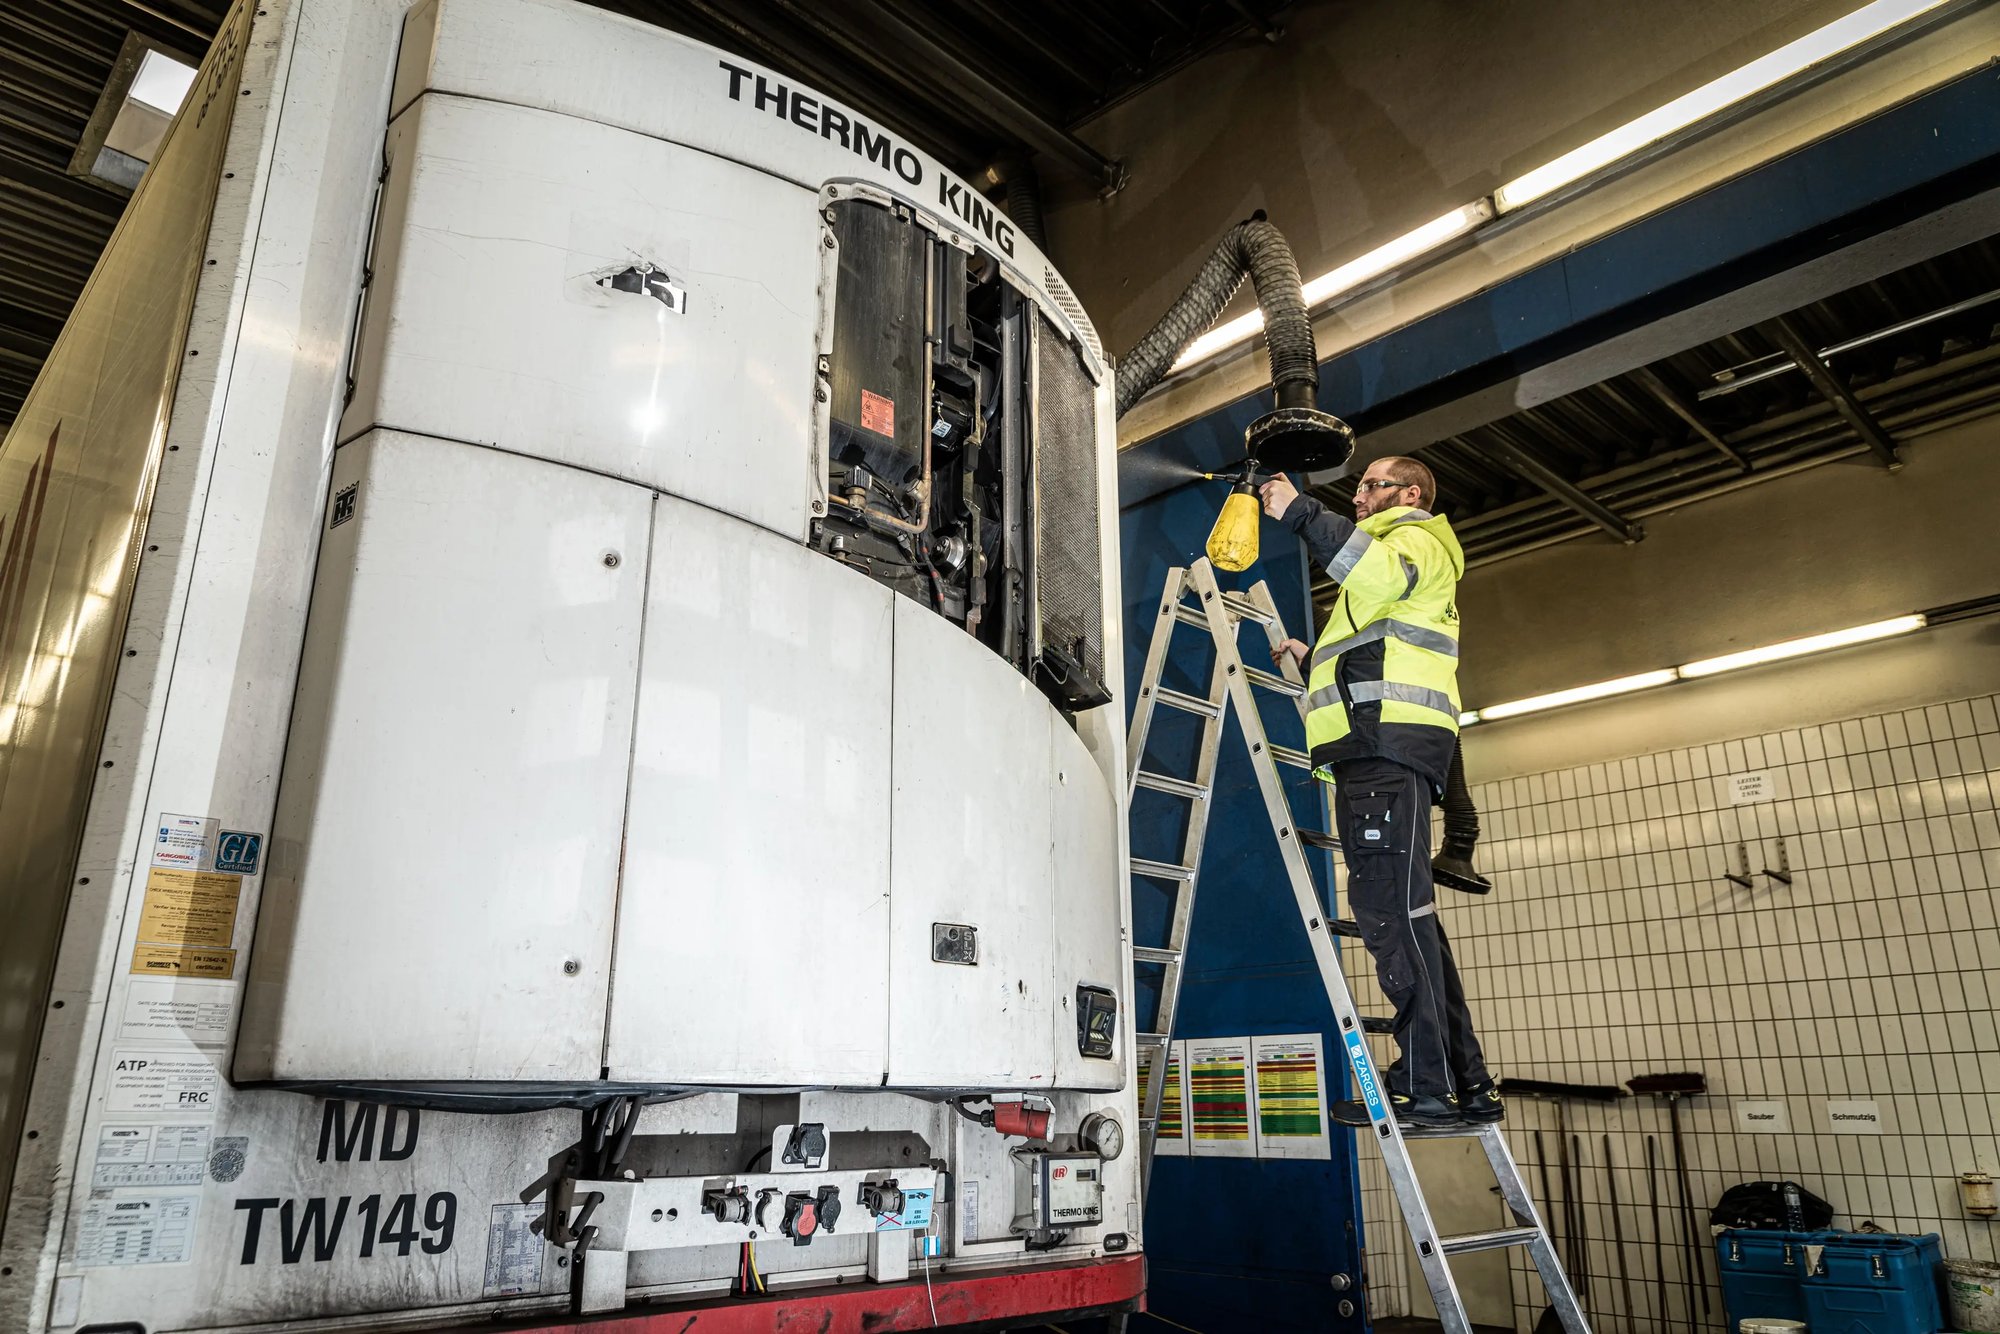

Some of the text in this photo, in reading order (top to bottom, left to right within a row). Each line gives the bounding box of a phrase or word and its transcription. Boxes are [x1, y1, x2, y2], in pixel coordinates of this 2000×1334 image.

[719, 60, 1015, 259] THERMO KING
[867, 392, 892, 406] WARNING
[220, 834, 255, 865] GL
[156, 852, 195, 861] CARGOBULL
[218, 862, 252, 872] Certified
[116, 1060, 147, 1071] ATP
[1356, 1058, 1379, 1107] ZARGES
[178, 1091, 209, 1103] FRC
[1832, 1113, 1876, 1122] Schmutzig
[317, 1100, 421, 1162] MD
[1054, 1166, 1066, 1178] IR
[1053, 1207, 1099, 1217] THERMO KING
